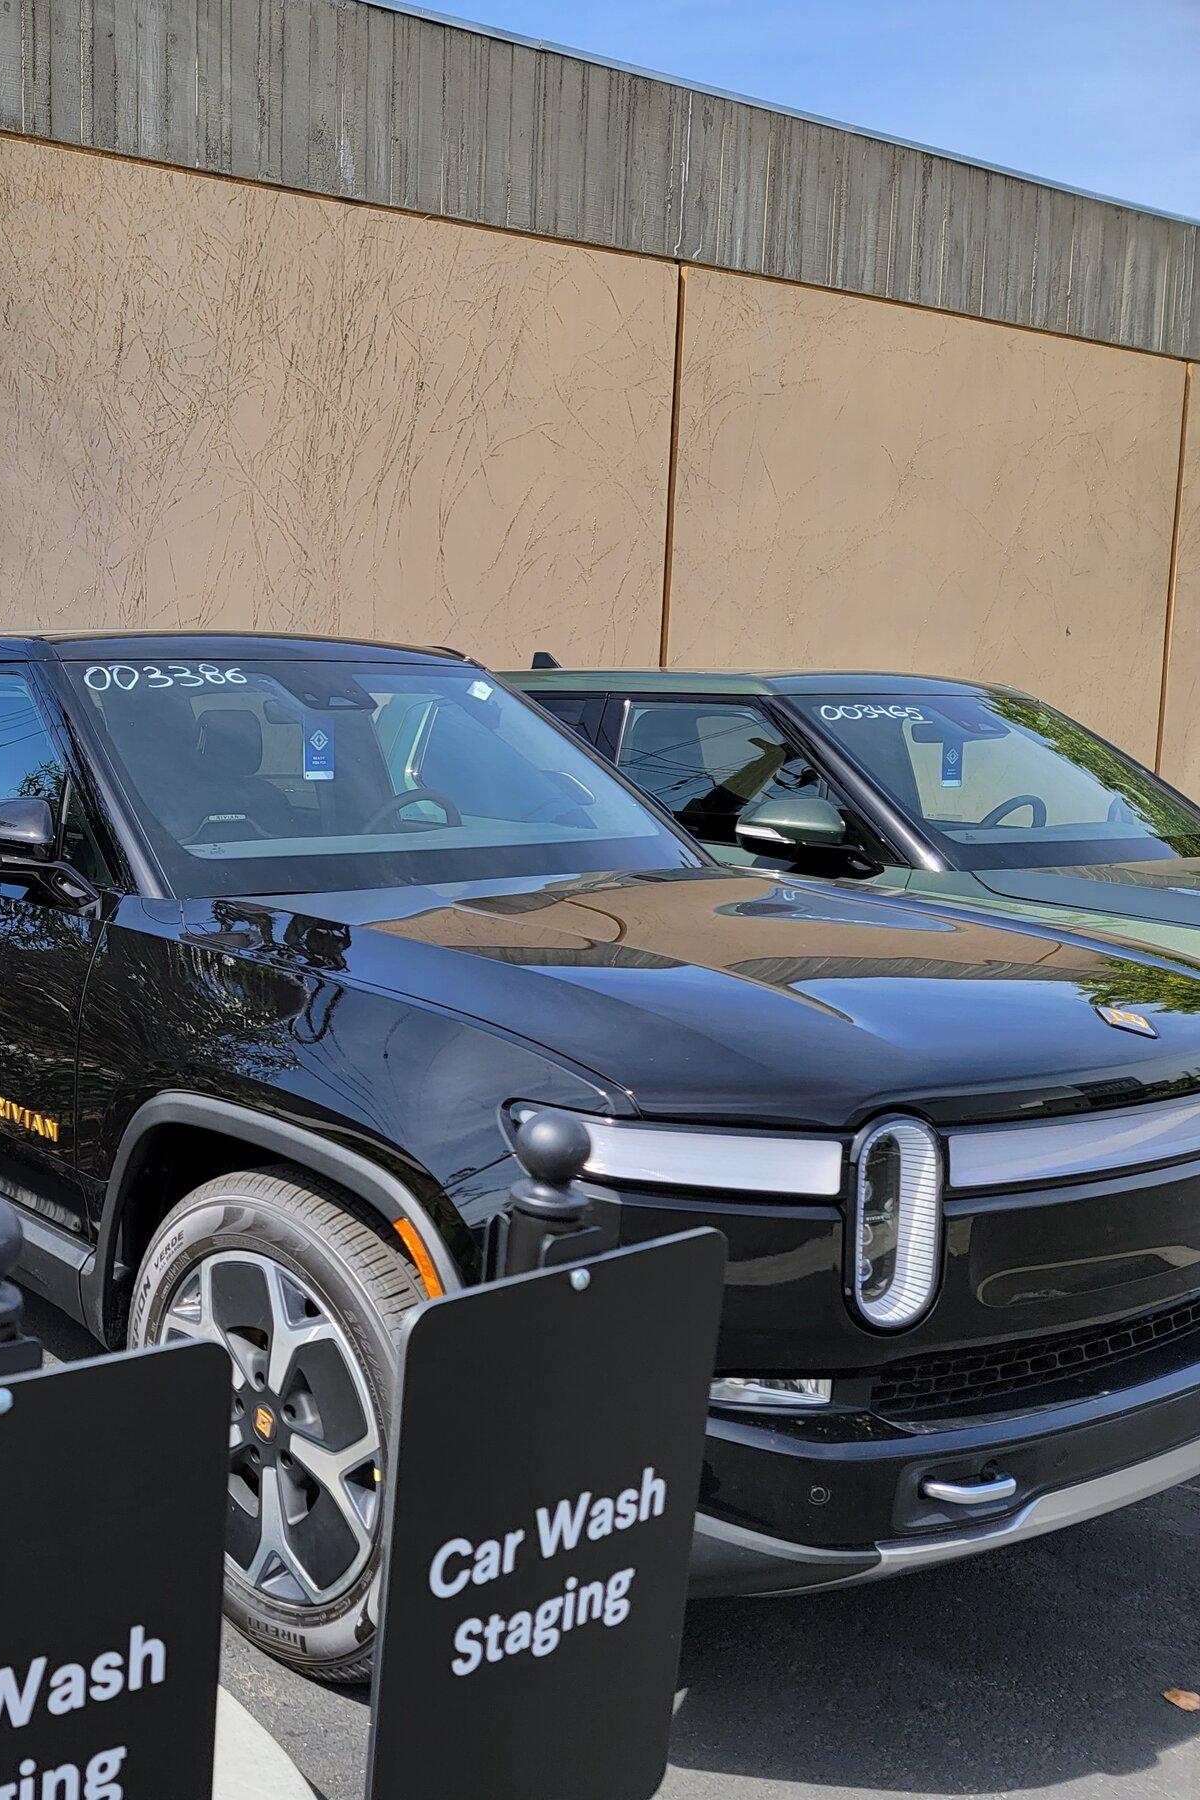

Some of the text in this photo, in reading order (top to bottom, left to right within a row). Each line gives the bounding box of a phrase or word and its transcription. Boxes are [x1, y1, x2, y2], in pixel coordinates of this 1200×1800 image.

[83, 663, 248, 691] 003386
[820, 704, 924, 721] 003465
[153, 1230, 184, 1270] VERDE
[429, 1528, 526, 1599] Car
[535, 1466, 667, 1559] Wash
[451, 1567, 635, 1676] Staging
